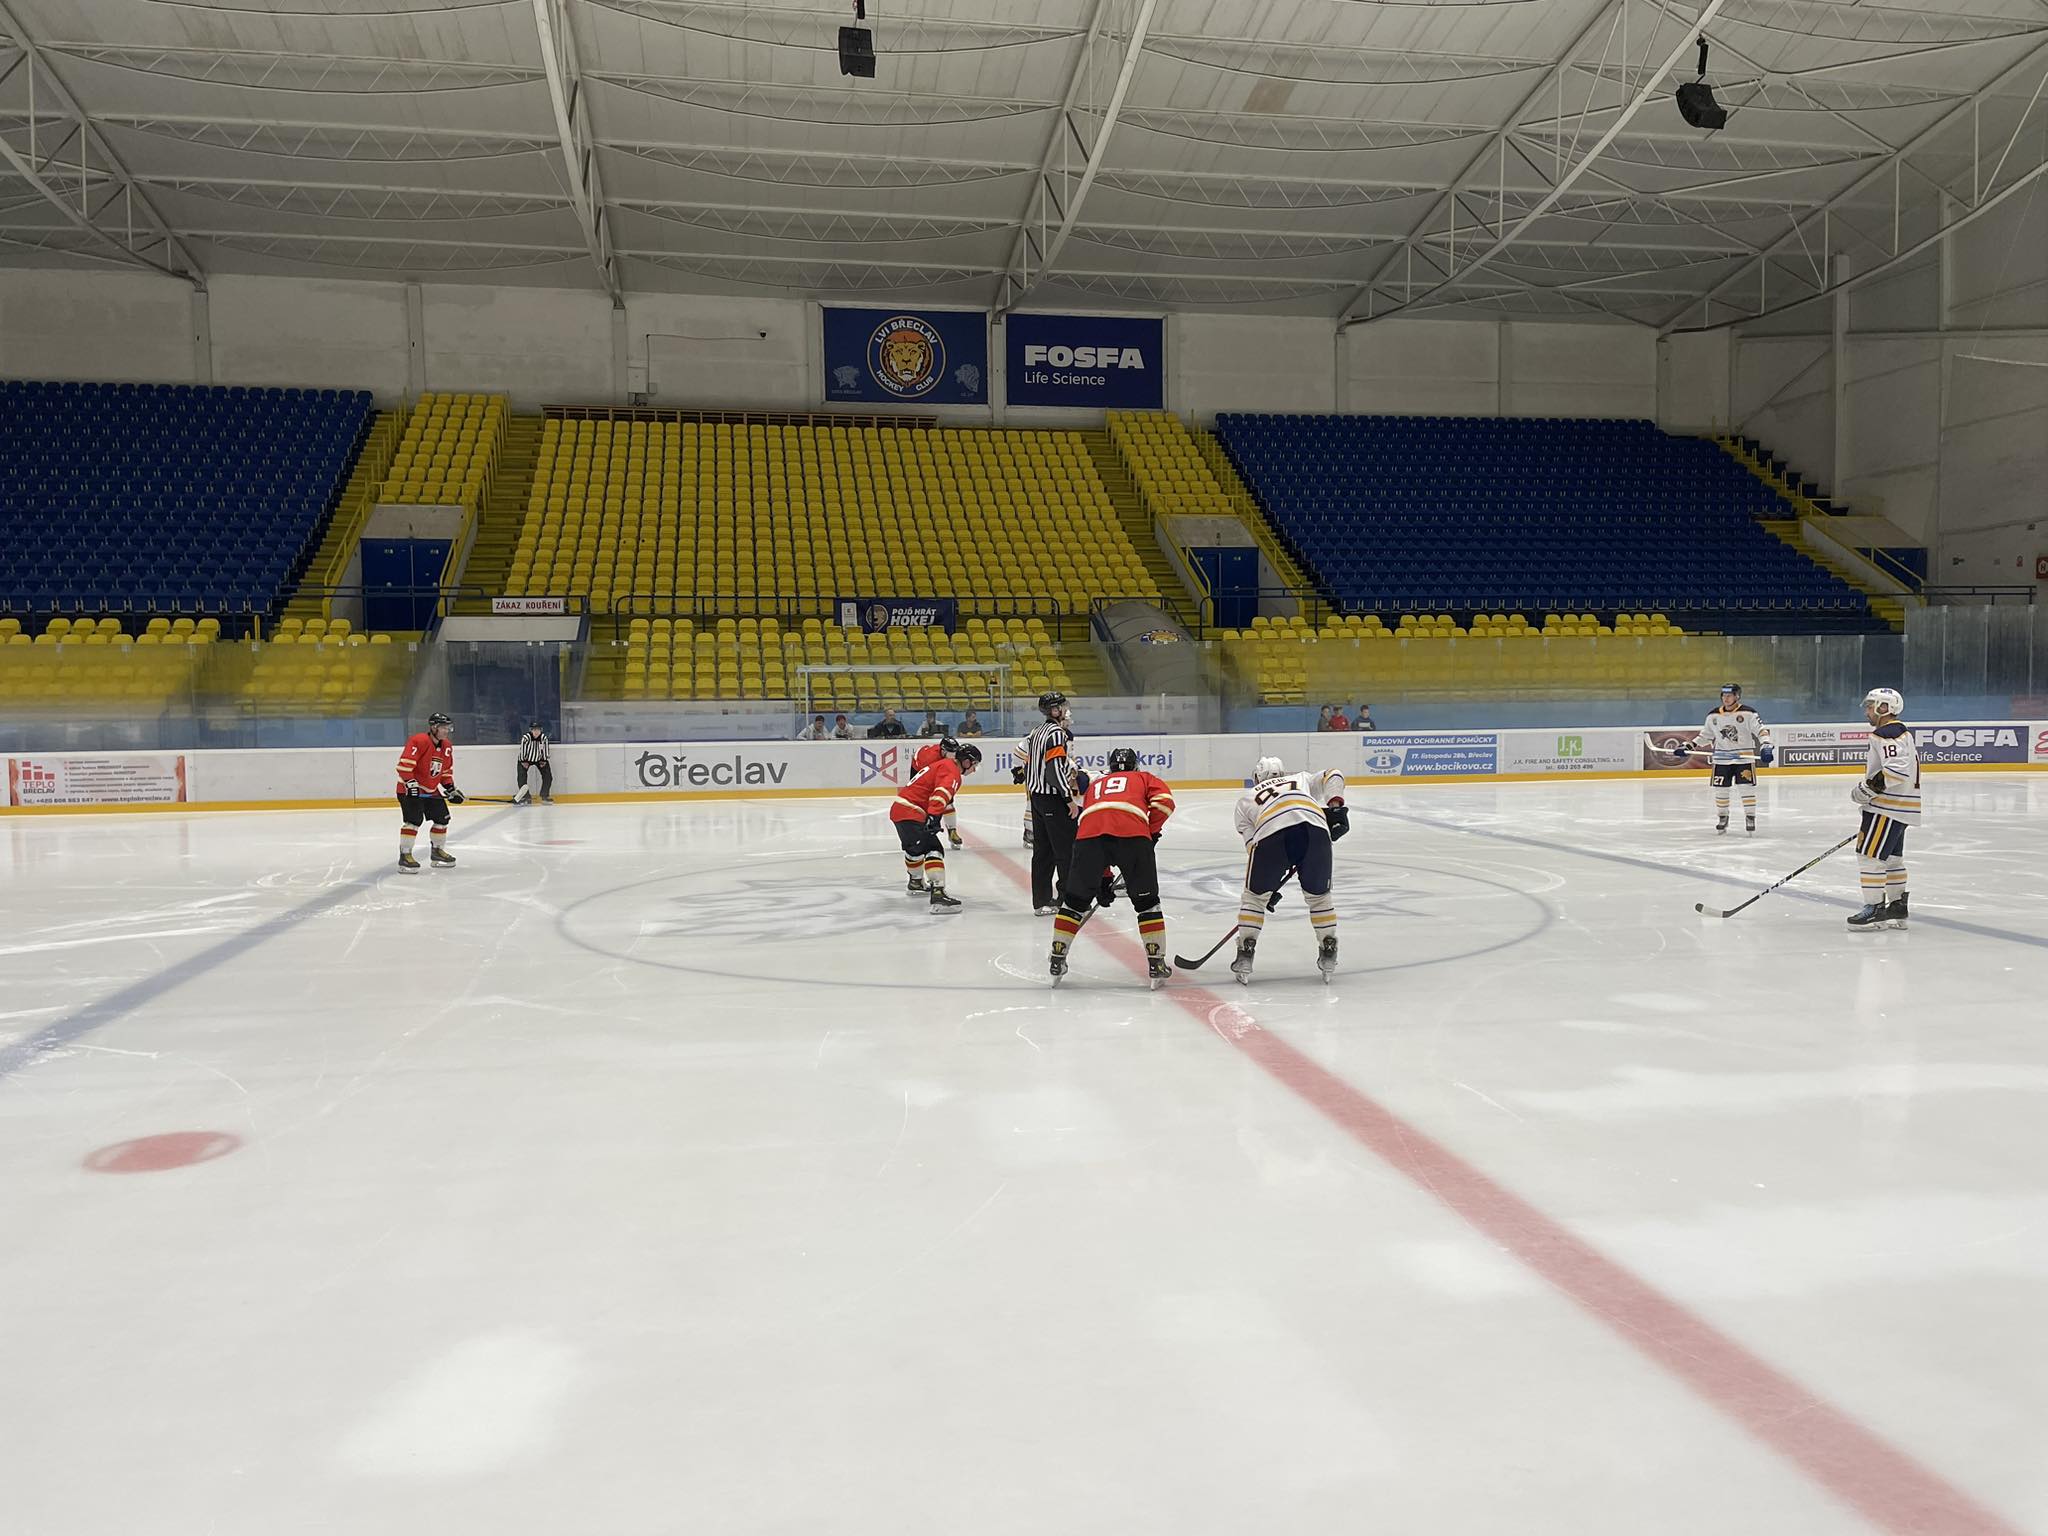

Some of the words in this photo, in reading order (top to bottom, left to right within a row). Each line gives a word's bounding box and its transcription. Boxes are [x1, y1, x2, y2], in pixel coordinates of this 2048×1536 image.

[874, 327, 890, 344] LVI
[1024, 344, 1145, 369] FOSFA
[876, 369, 904, 393] HOCKEY
[915, 376, 935, 392] CLUB
[1024, 372, 1049, 384] Life
[1052, 372, 1106, 386] Science
[495, 600, 521, 610] ZÁKAZ
[525, 599, 561, 610] KOUŘENÍ
[892, 606, 912, 616] POJĎ
[914, 606, 937, 616] HRÁT
[890, 615, 935, 626] HOKEJ
[1366, 737, 1405, 745] PRACOVNÍ
[1406, 737, 1412, 745] A
[1413, 736, 1455, 744] OCHRANNÉ
[1456, 735, 1493, 744] POMŮCKY
[1914, 729, 2019, 747] FOSFA
[411, 747, 418, 755] 7
[444, 747, 451, 756] C
[1788, 750, 1834, 761] KUCHYNĚ
[1882, 745, 1898, 759] 18
[1936, 751, 1983, 762] Science
[1137, 750, 1173, 769] kraj
[634, 750, 788, 787] Břeclav
[23, 780, 55, 789] TEPLO
[1713, 776, 1725, 786] 27
[1093, 776, 1128, 800] 19
